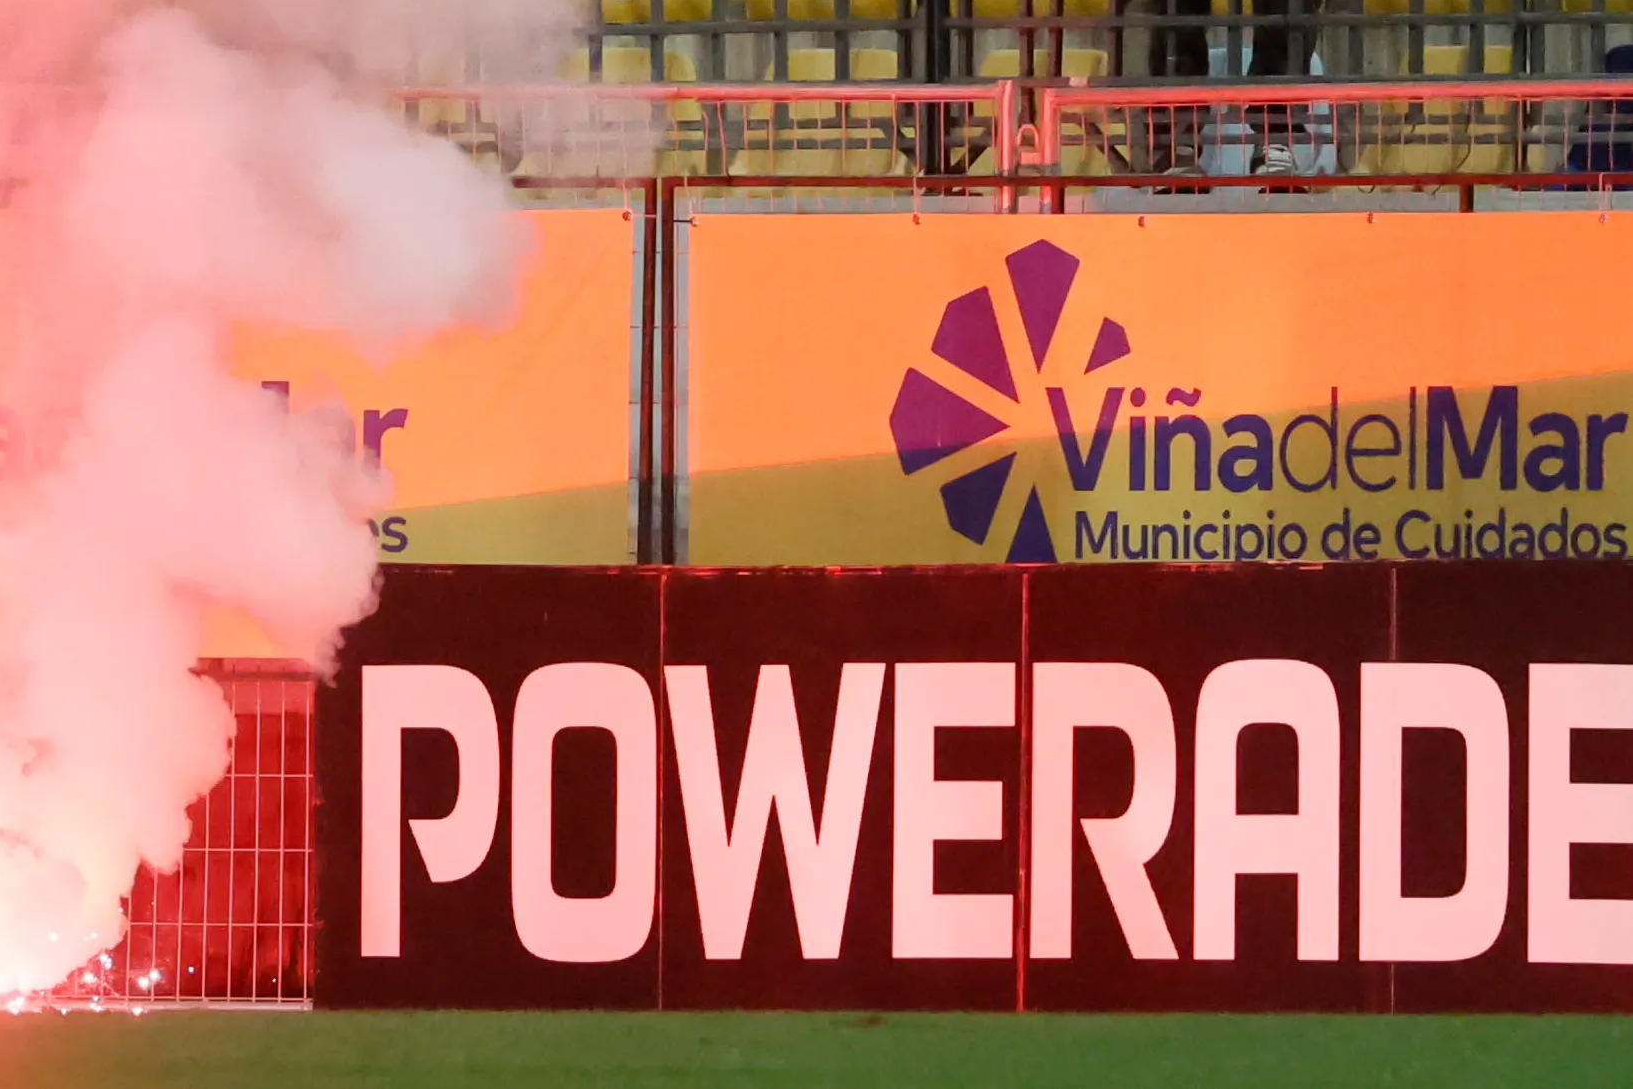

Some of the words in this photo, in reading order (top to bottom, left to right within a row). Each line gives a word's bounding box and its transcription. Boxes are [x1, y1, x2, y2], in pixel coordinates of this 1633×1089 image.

[1074, 510, 1308, 561] Municipio
[1321, 508, 1382, 561] de
[1395, 508, 1629, 561] Cuidados
[361, 658, 1633, 964] POWERADE
